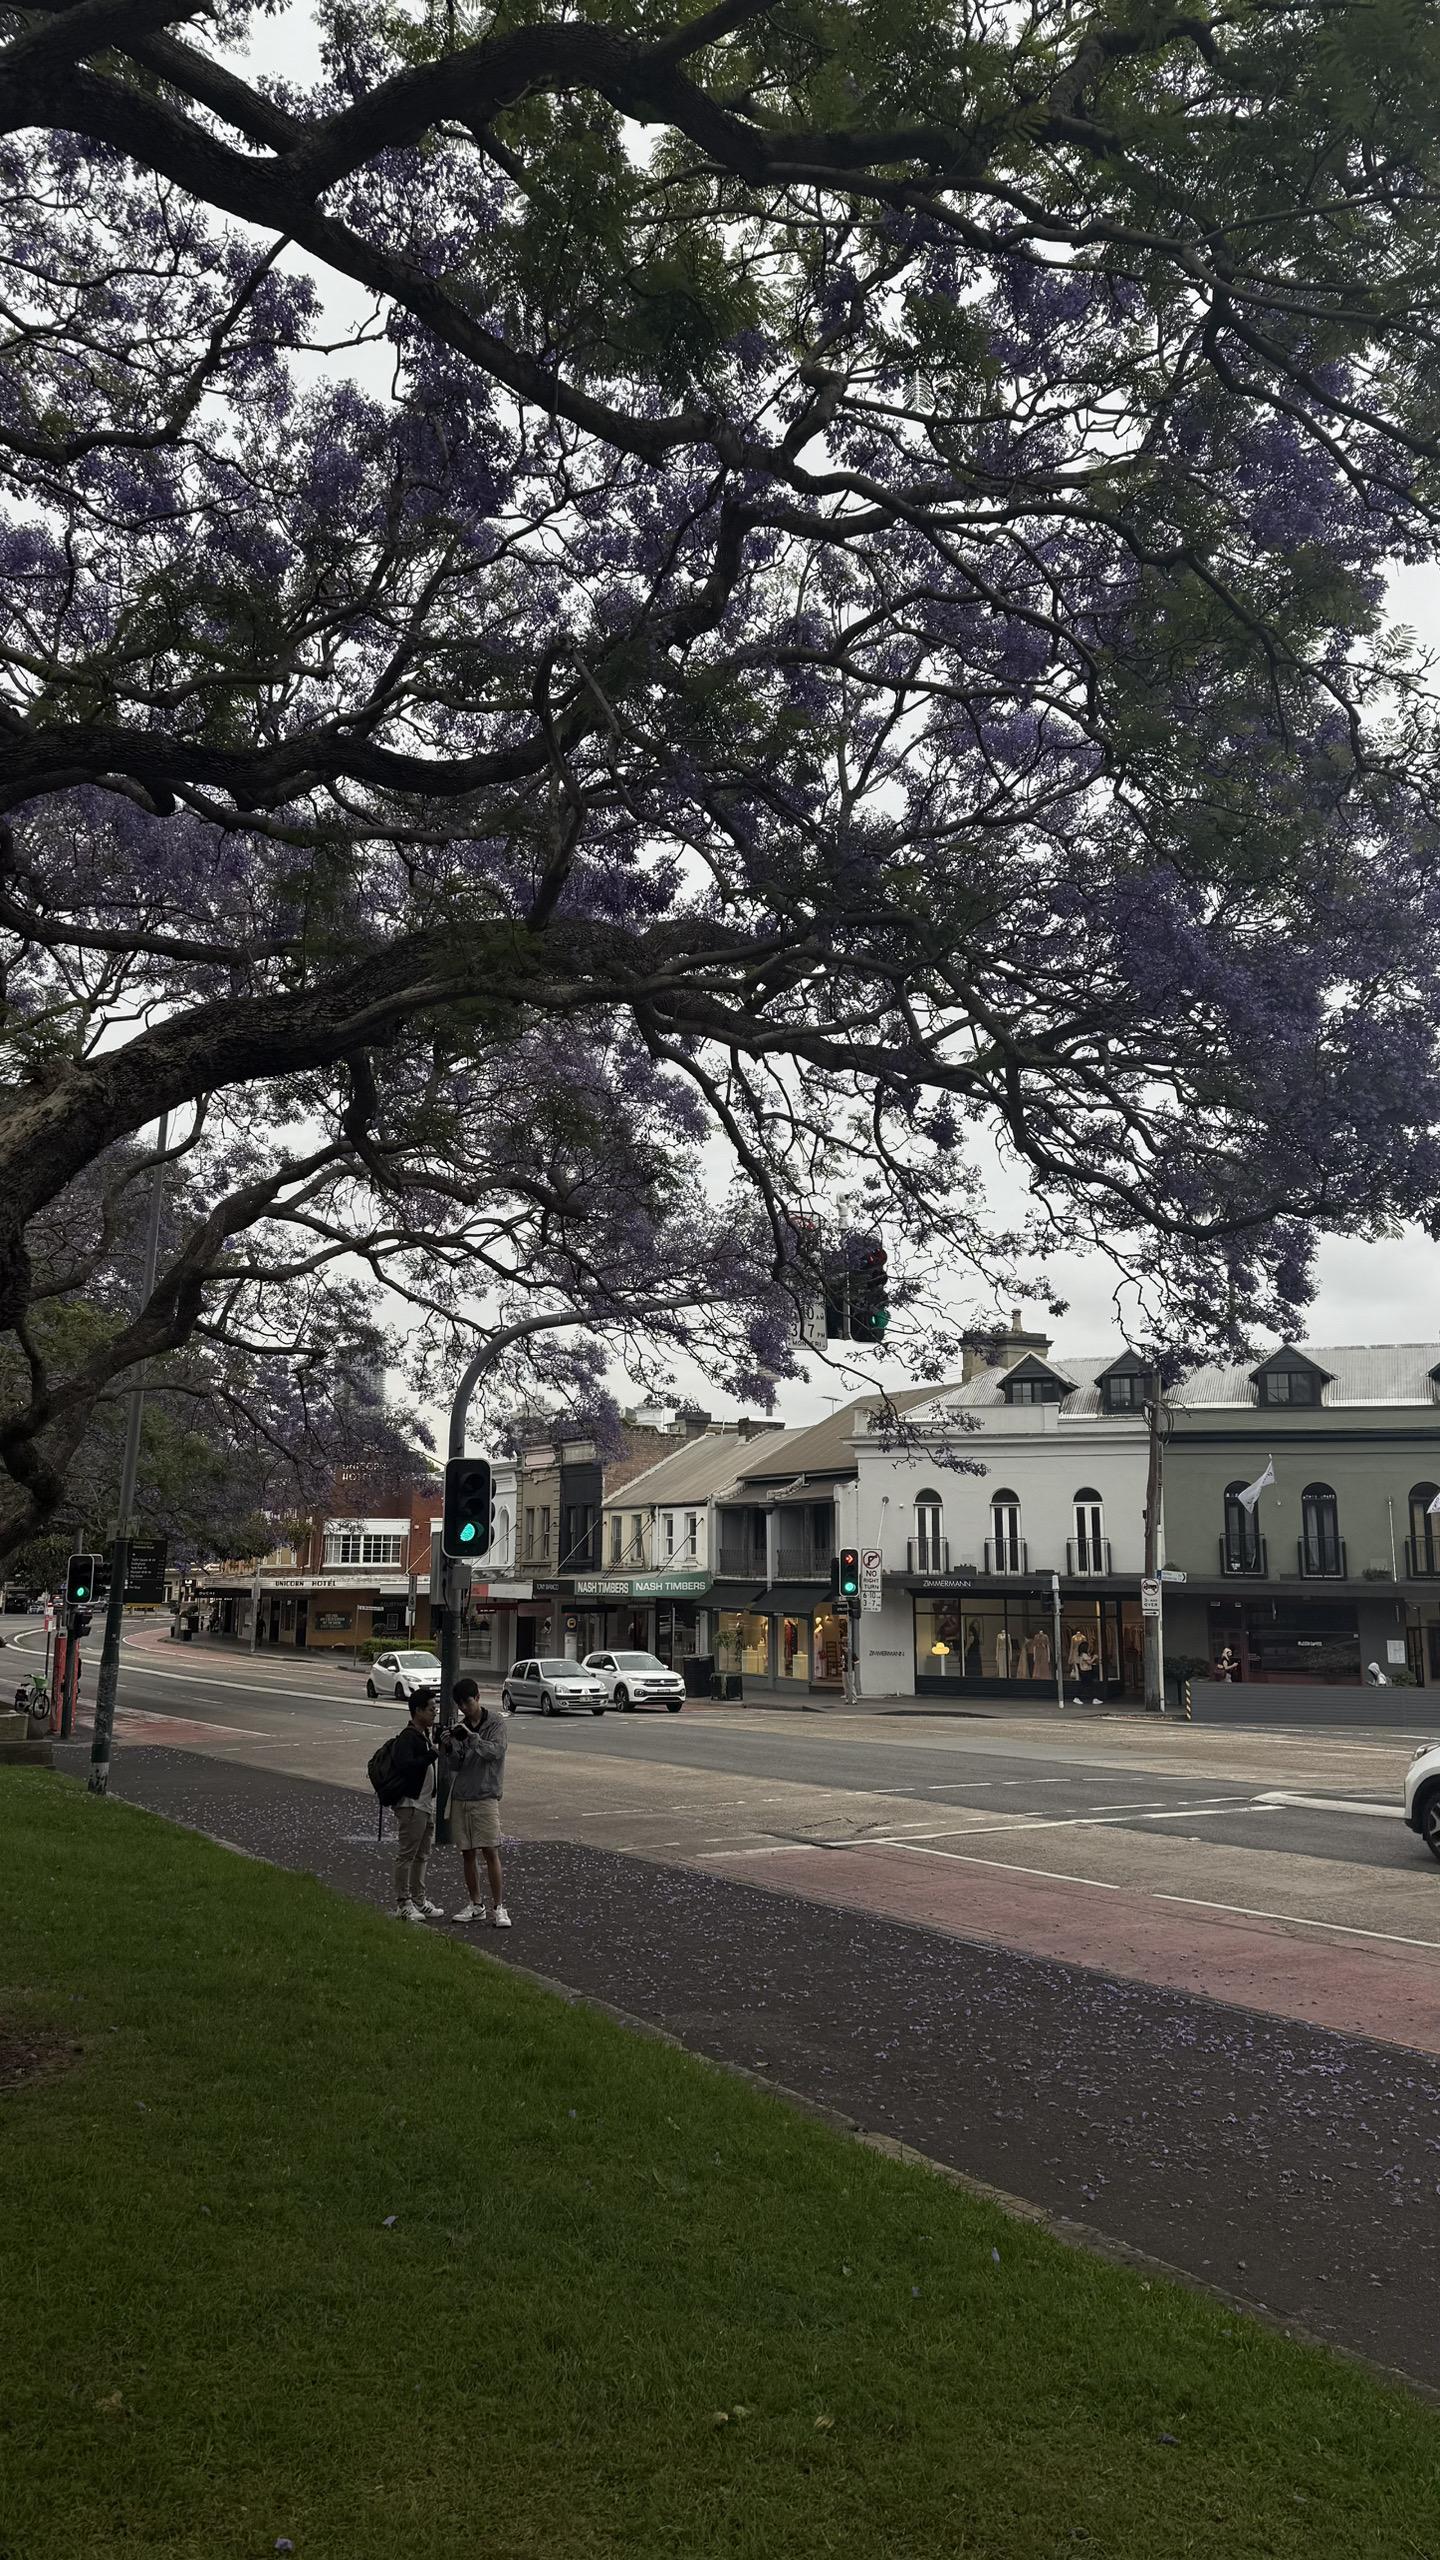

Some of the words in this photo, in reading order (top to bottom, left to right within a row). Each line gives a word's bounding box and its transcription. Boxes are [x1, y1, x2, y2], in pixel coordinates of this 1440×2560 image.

[866, 1570, 877, 1578] NO
[577, 1582, 598, 1594] NASH
[598, 1582, 629, 1594] TIMBERS
[635, 1582, 663, 1591] NASH
[665, 1581, 706, 1590] TIMBERS
